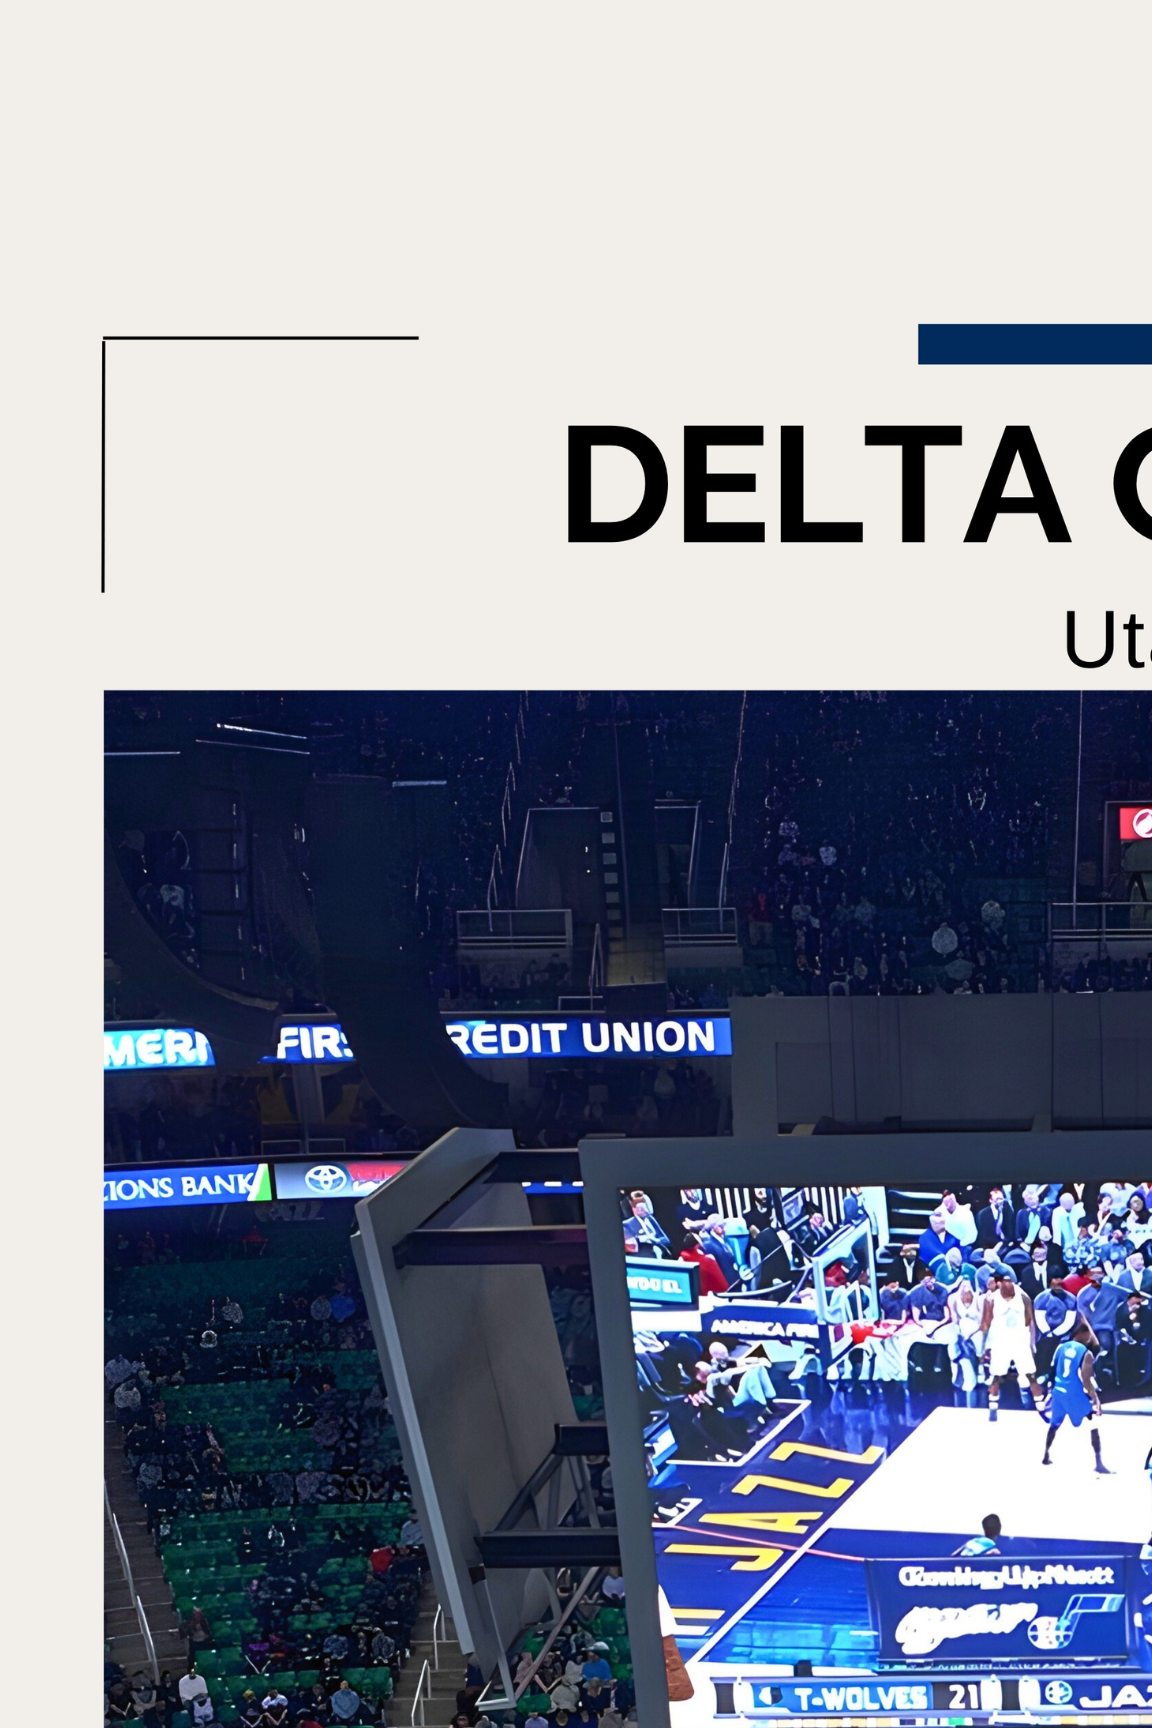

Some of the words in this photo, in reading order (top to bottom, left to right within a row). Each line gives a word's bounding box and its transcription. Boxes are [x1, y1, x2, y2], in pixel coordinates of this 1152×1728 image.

[582, 1020, 716, 1053] UNION
[181, 1172, 255, 1197] BANK
[664, 1442, 886, 1572] JAZZ
[794, 1686, 927, 1710] T-WOLVES
[948, 1684, 979, 1709] 21
